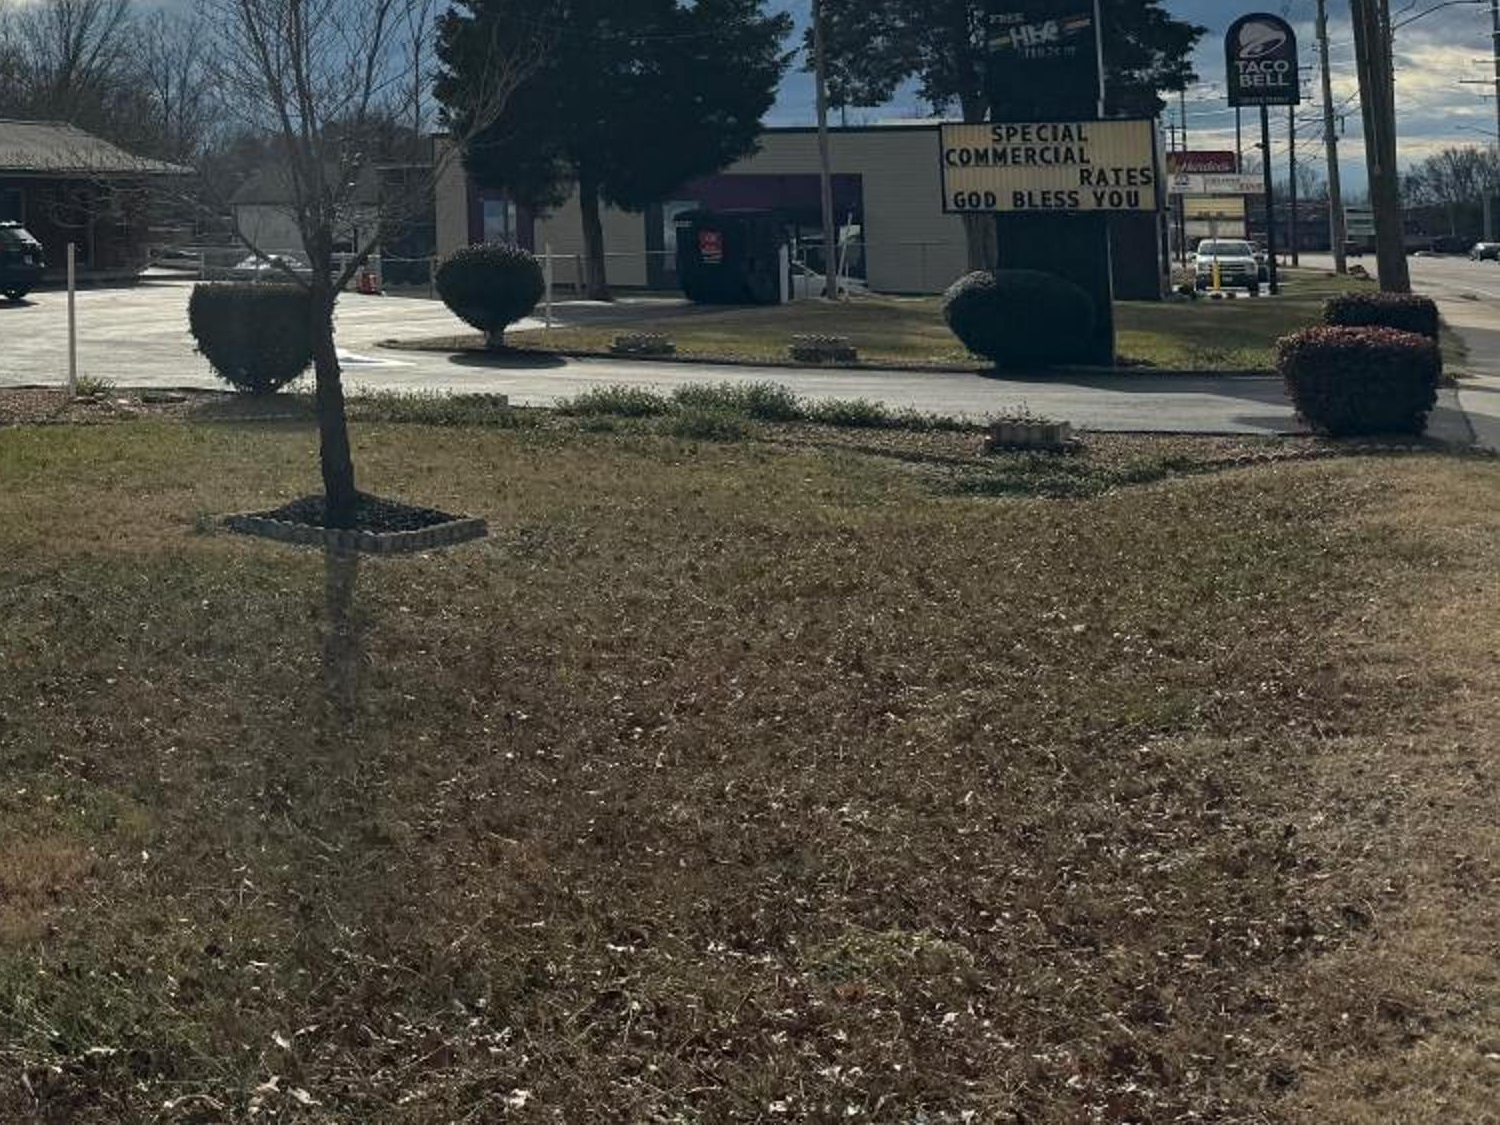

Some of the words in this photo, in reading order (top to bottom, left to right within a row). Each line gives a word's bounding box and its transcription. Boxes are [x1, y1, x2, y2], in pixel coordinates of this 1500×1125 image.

[1235, 59, 1290, 74] TACO
[1239, 73, 1292, 88] BELL
[992, 125, 1089, 143] SPECIAL
[945, 146, 1091, 165] COMMERCIAL
[1079, 167, 1153, 187] RATES
[953, 190, 997, 209] GOD
[1012, 190, 1080, 209] BLESS
[1092, 189, 1140, 208] YOU
